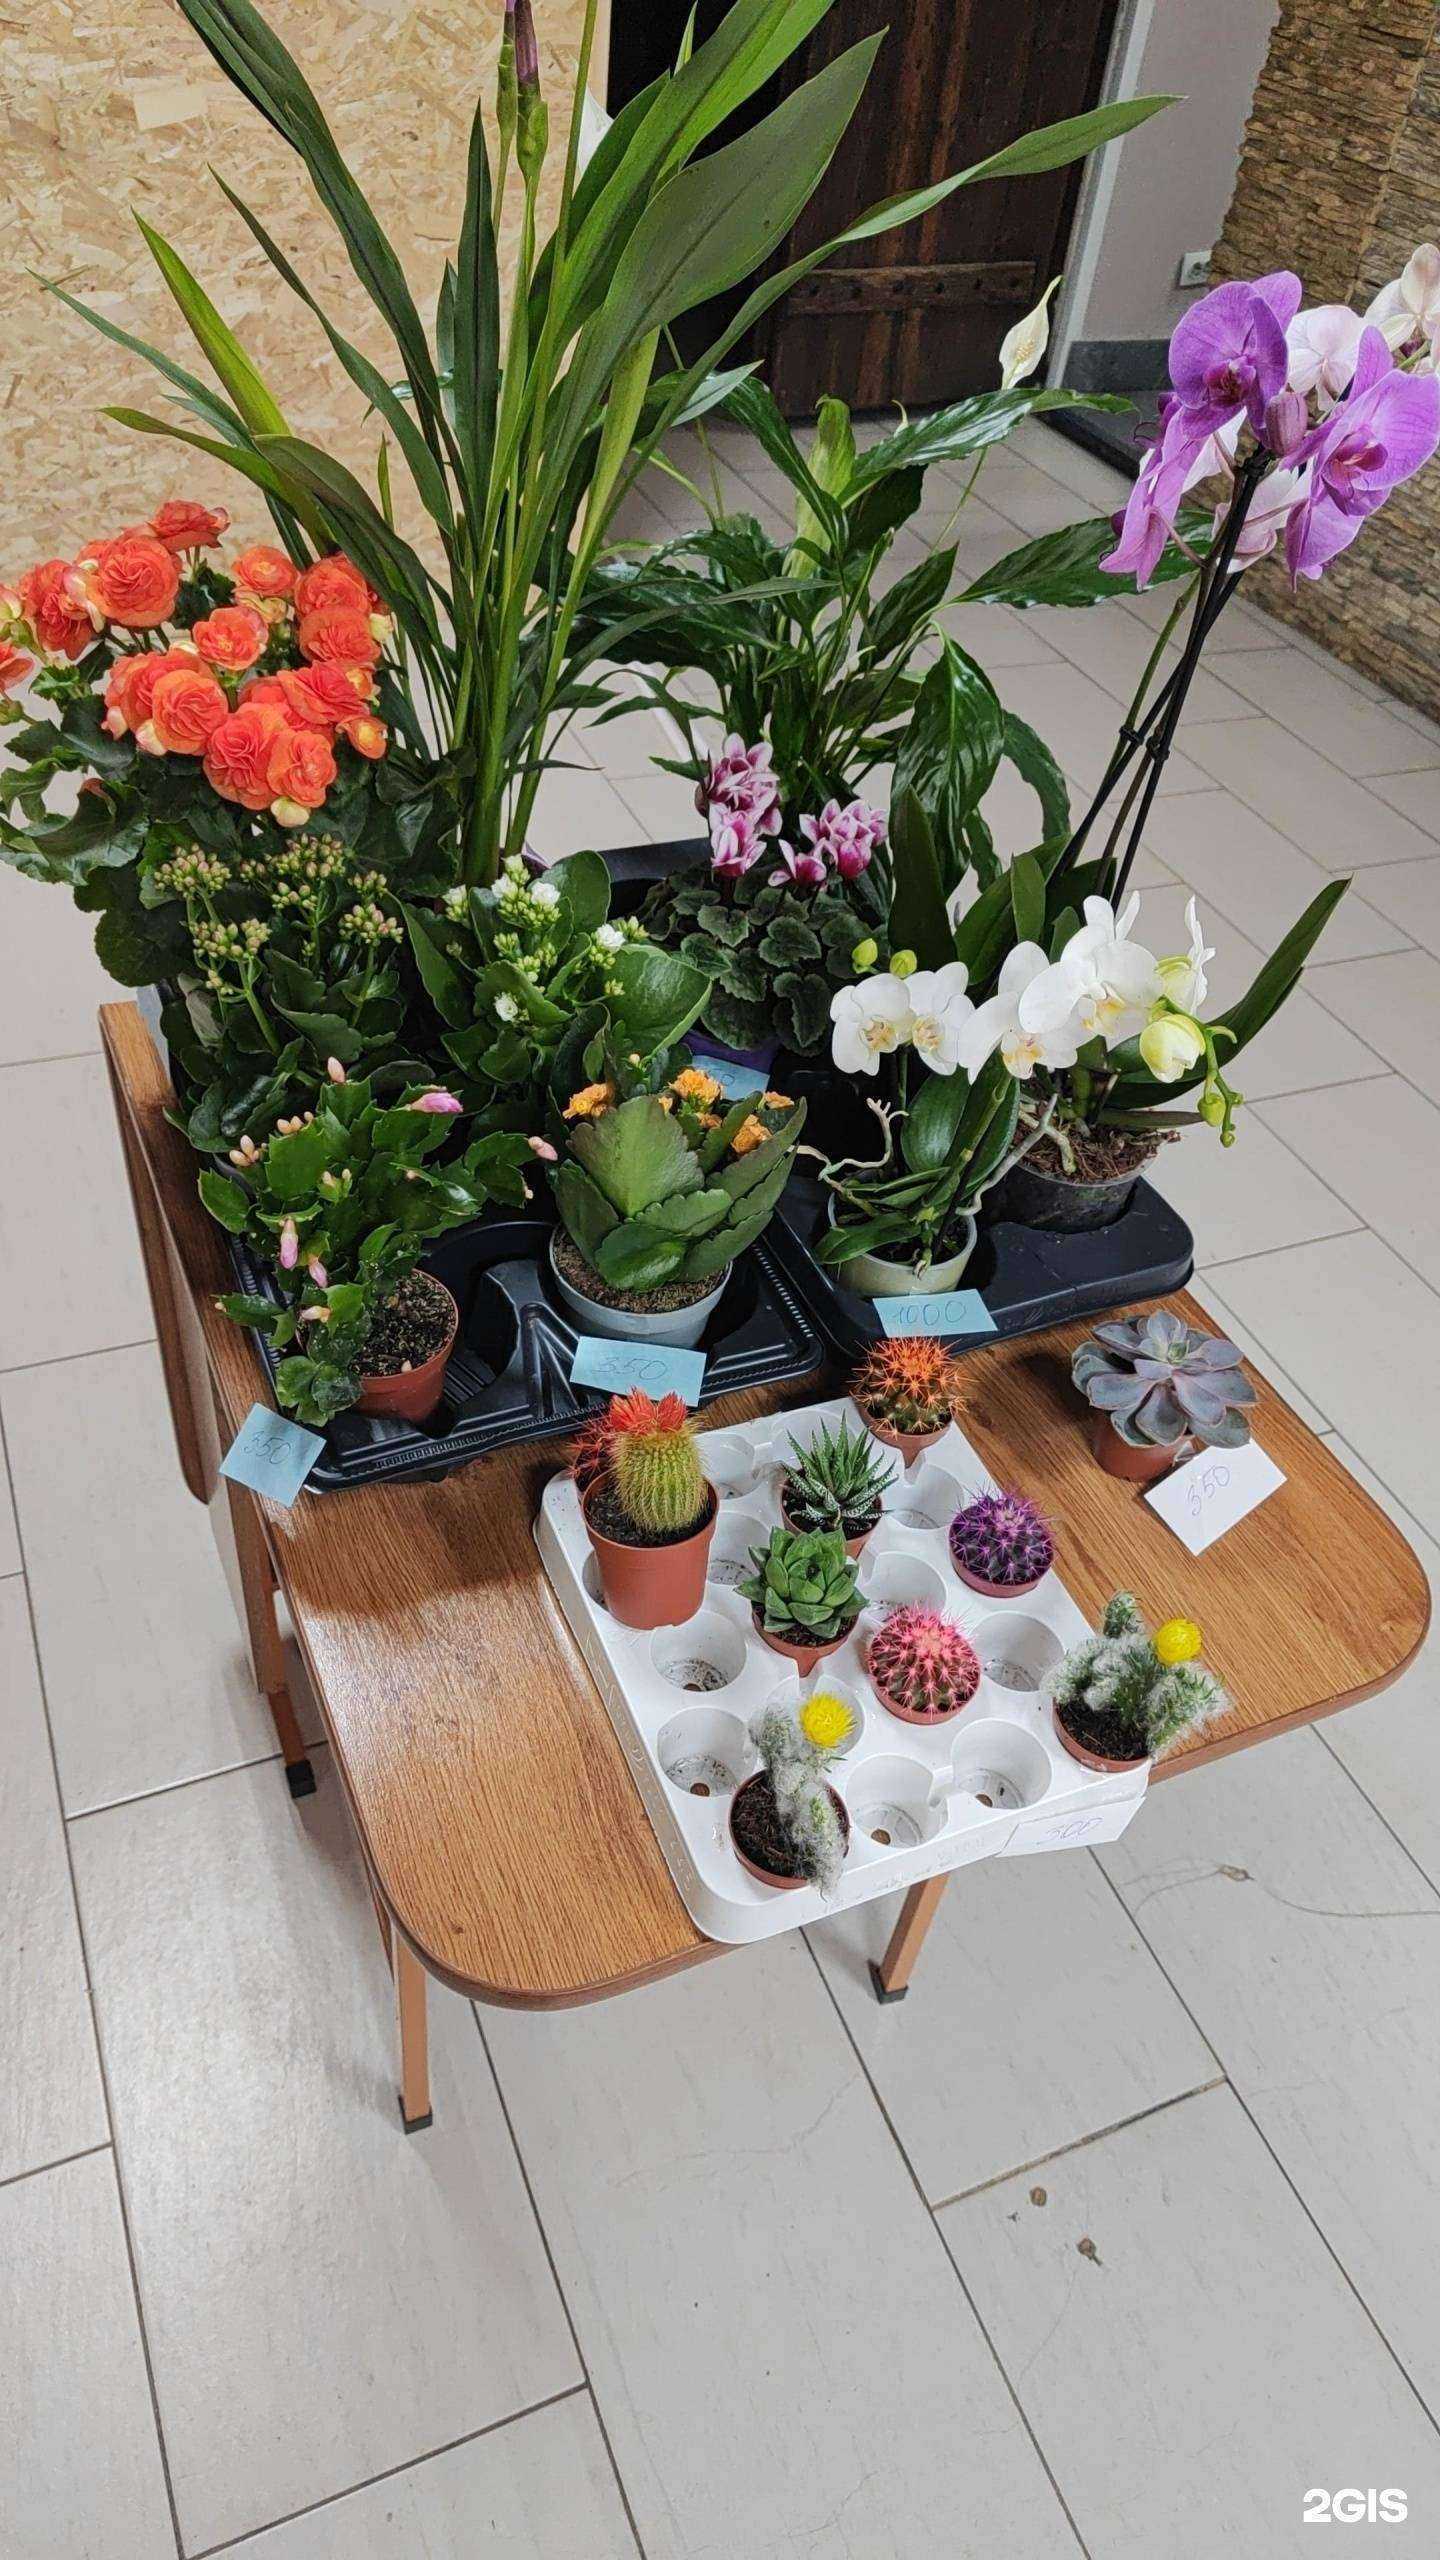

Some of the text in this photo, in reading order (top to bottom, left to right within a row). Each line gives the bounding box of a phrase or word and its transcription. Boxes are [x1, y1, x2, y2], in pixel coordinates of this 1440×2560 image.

[893, 1300, 967, 1327] 1000
[591, 1356, 668, 1380] 350
[243, 1430, 292, 1465] 350
[1187, 1465, 1231, 1517] 350
